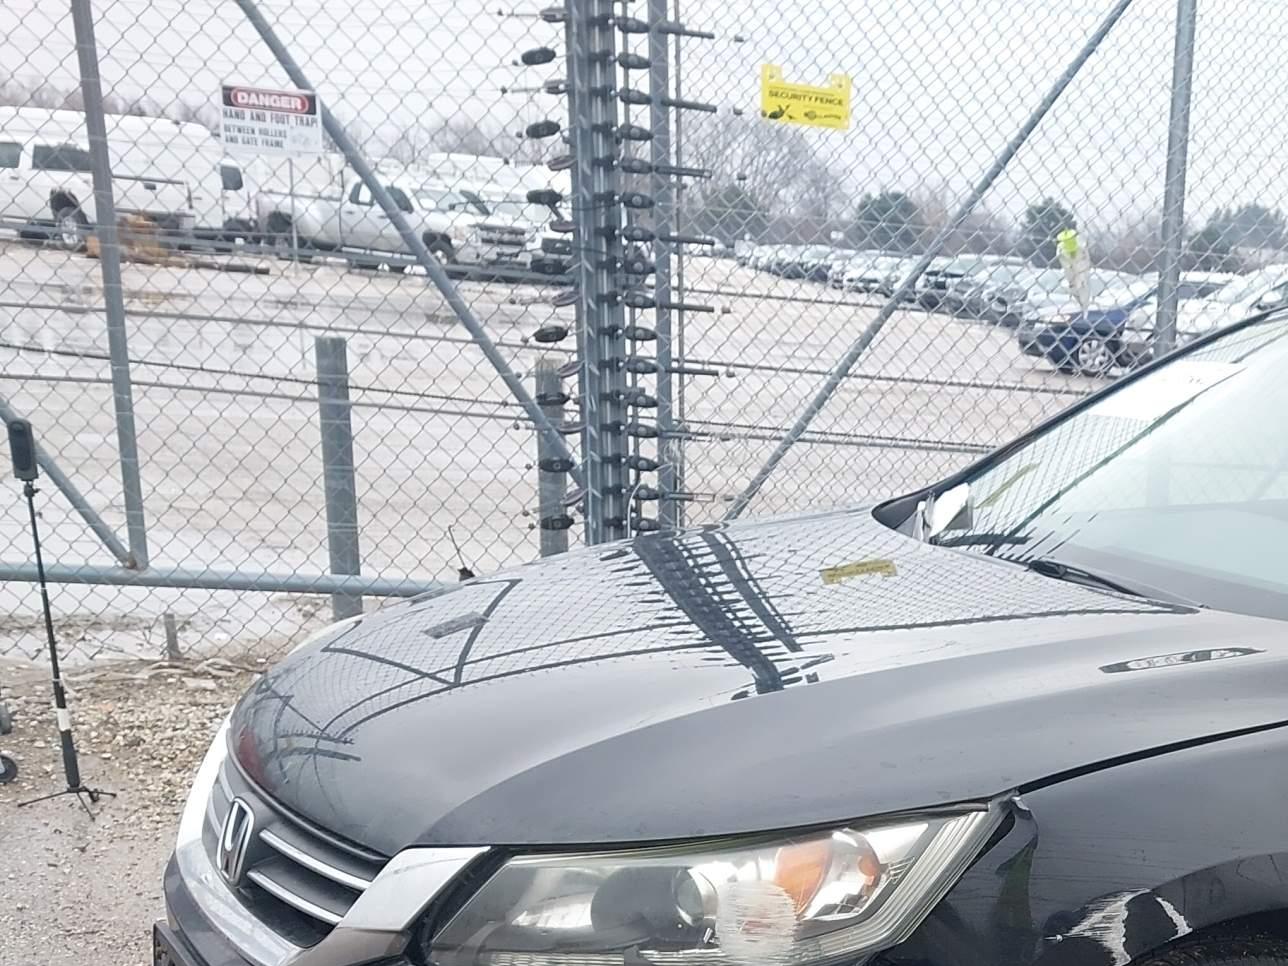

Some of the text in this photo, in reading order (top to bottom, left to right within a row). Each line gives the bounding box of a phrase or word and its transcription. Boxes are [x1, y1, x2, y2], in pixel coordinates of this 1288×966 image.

[236, 91, 303, 110] DANGER
[768, 90, 813, 102] SECURITY
[814, 95, 844, 106] FENCE
[223, 108, 246, 120] HAND
[250, 111, 266, 122] AND
[270, 112, 290, 125] FOOT
[223, 123, 256, 135] BETWEEN
[225, 135, 239, 144] AND
[242, 136, 258, 146] GATE
